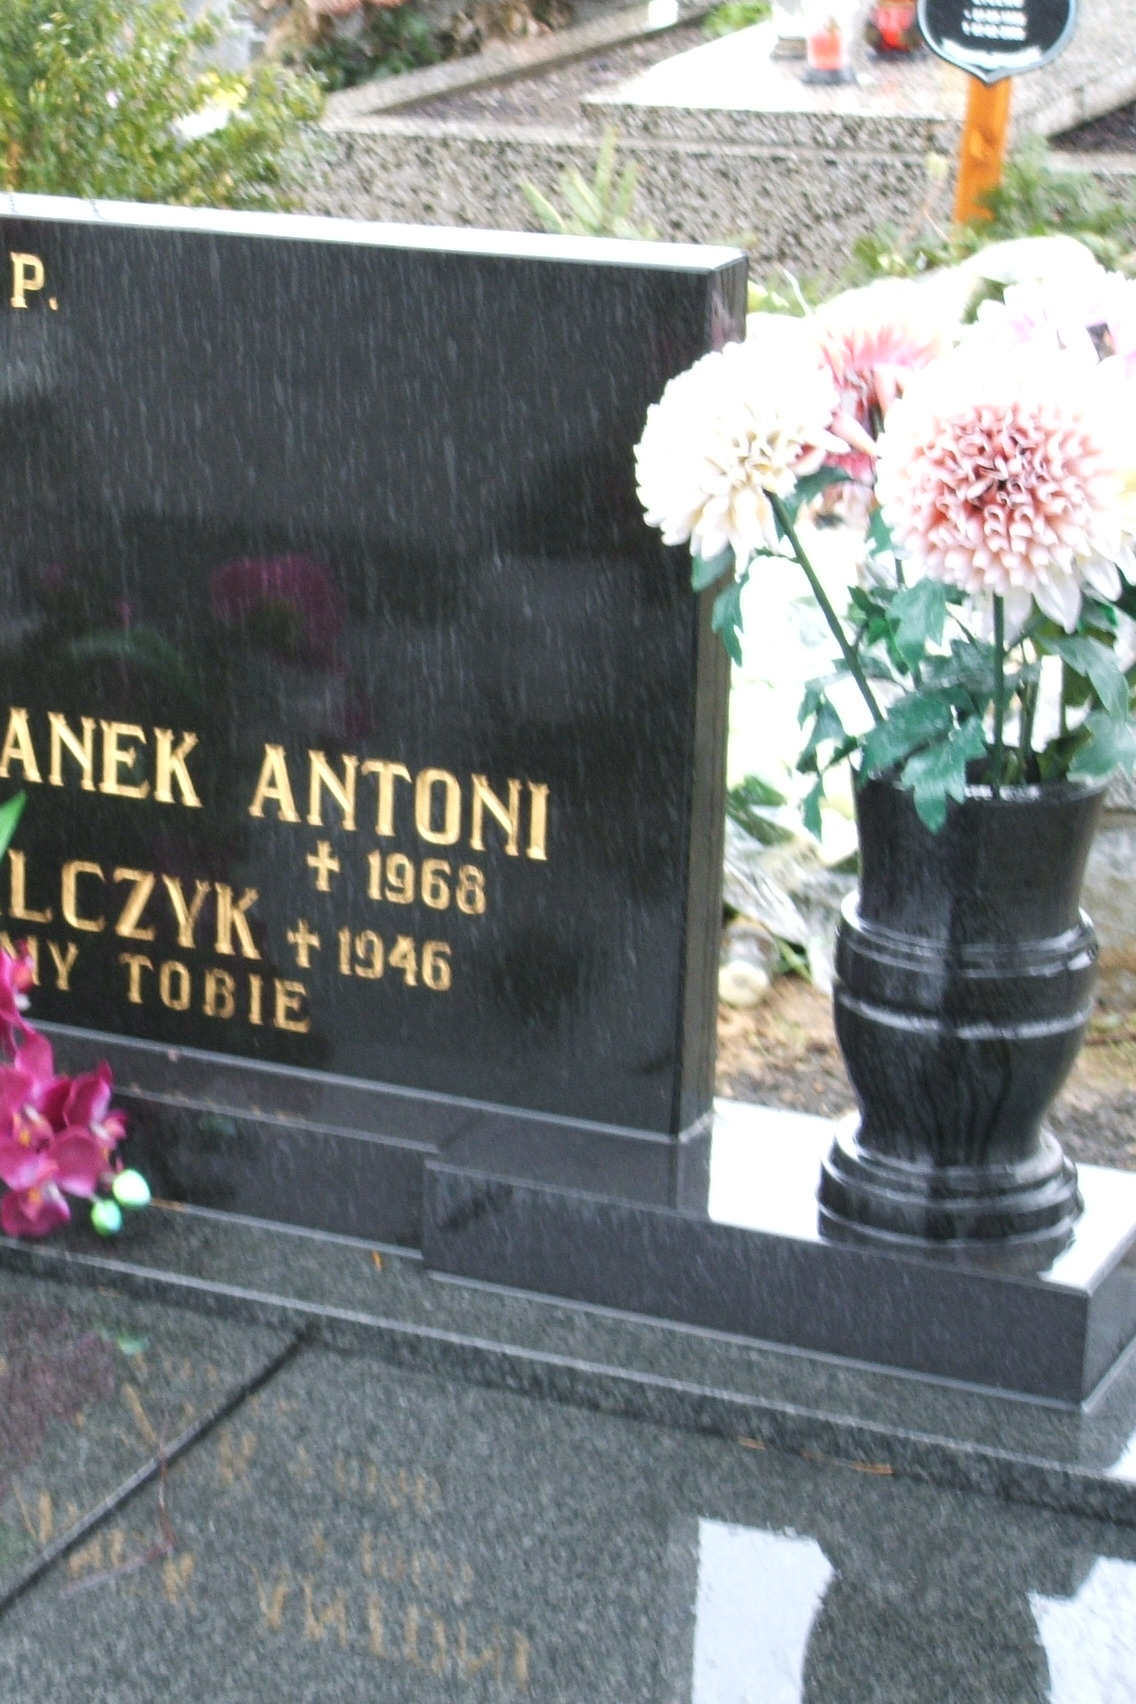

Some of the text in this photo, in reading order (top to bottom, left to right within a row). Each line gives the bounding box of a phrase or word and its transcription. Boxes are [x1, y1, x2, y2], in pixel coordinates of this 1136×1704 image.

[10, 251, 59, 311] P.
[249, 743, 550, 860] ANTONI
[366, 848, 486, 915] 1968
[337, 925, 453, 992] 1946
[120, 953, 311, 1034] TOBIE
